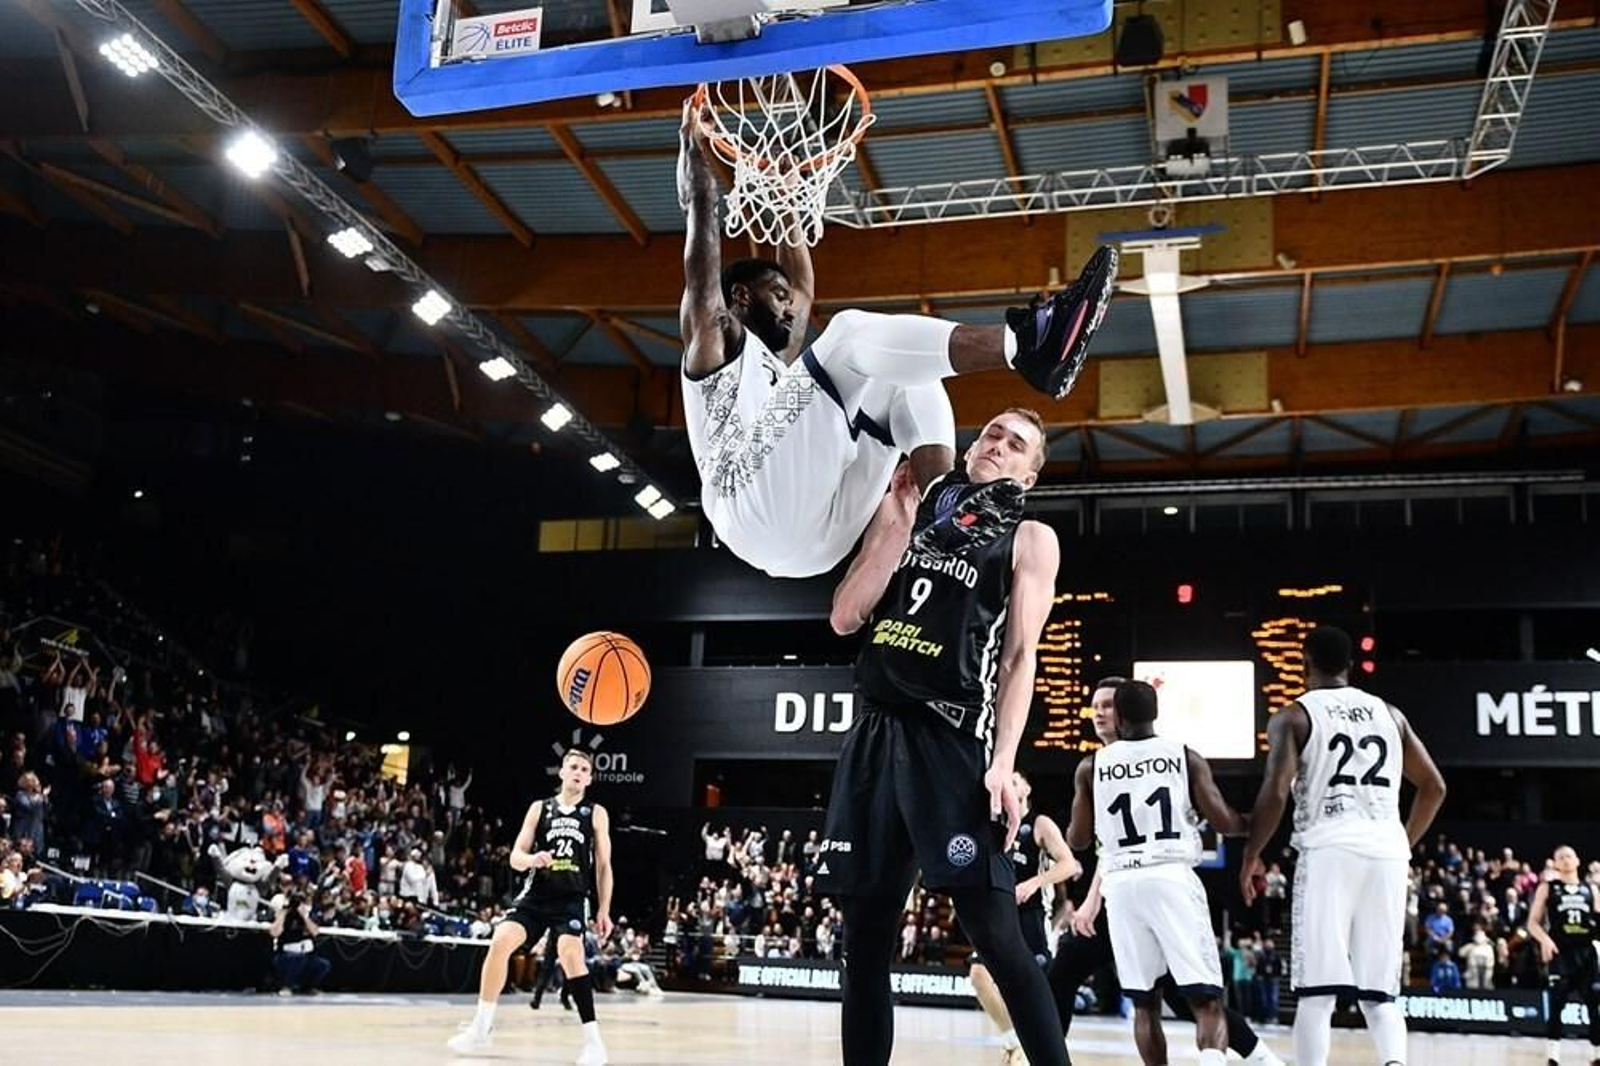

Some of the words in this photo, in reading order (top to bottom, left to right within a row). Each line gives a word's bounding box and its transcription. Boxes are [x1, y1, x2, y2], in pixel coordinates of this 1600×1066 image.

[906, 577, 934, 615] 9
[873, 631, 943, 657] MATCH
[874, 619, 922, 638] PARI
[775, 692, 854, 732] DIJ
[1099, 757, 1181, 782] HOLSTON
[1328, 732, 1391, 788] 22
[1107, 787, 1181, 848] 11
